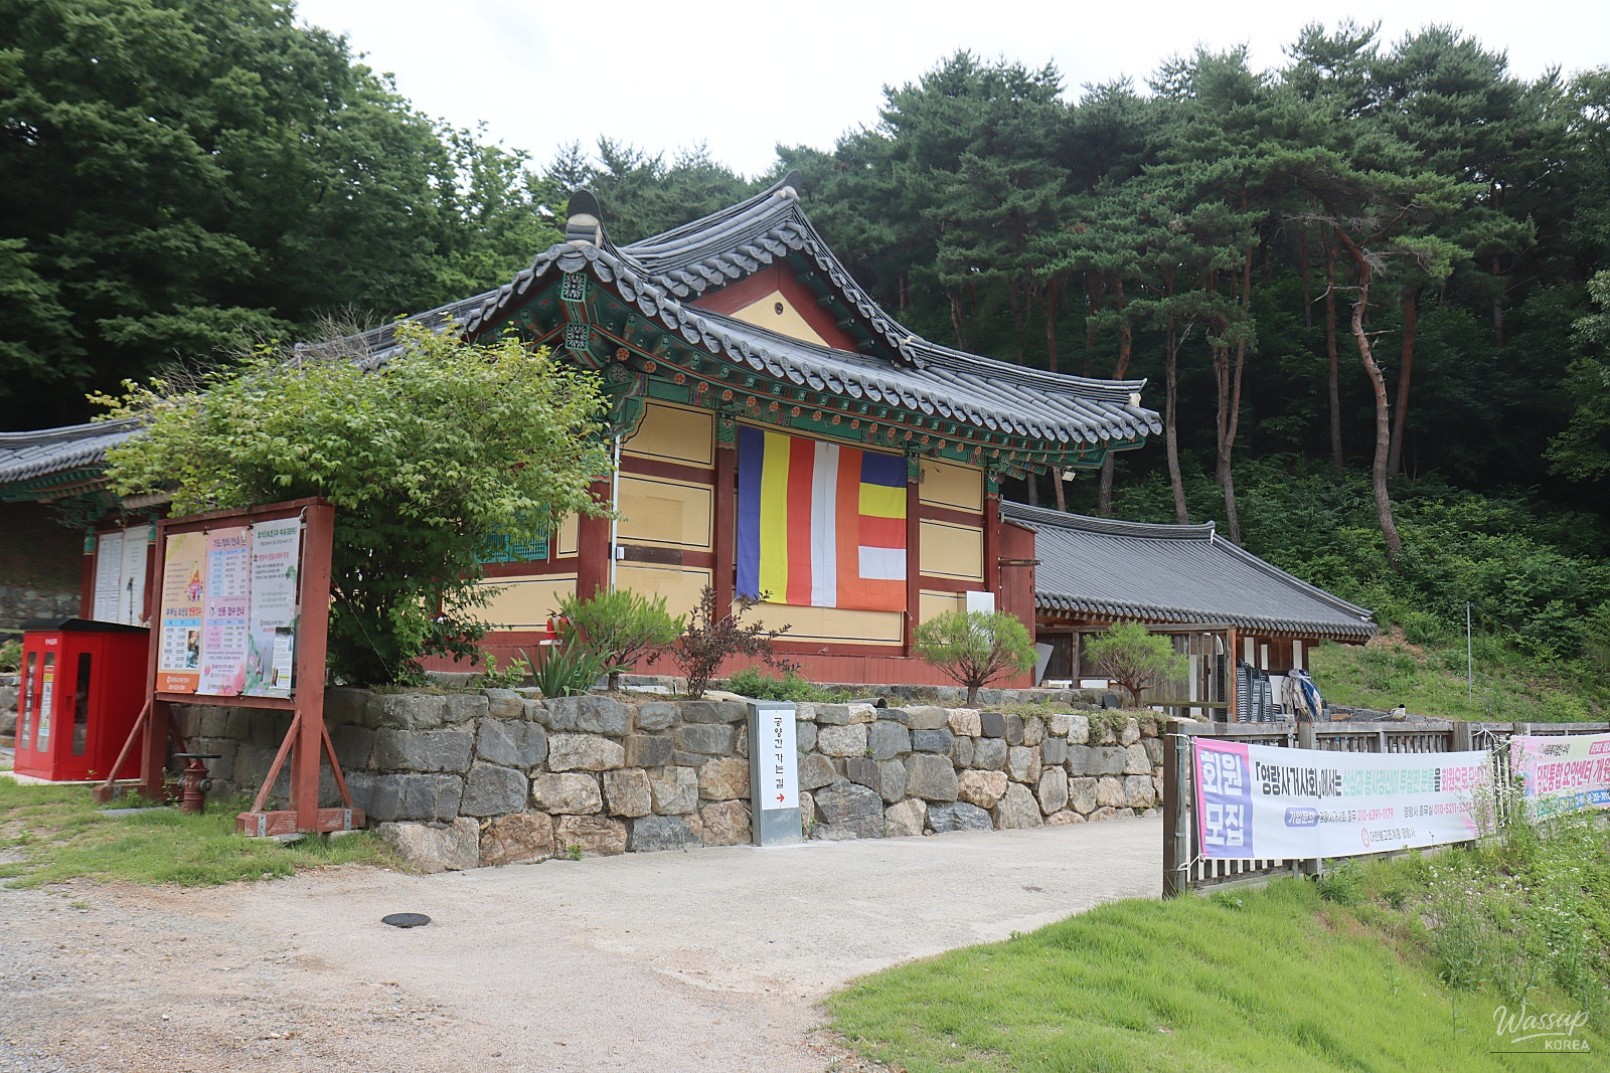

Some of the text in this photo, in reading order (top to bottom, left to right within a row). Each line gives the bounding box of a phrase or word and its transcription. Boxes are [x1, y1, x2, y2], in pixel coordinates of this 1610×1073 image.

[774, 717, 784, 789] 공양간 가는 길
[1200, 750, 1243, 796] 회원
[1205, 803, 1244, 846] 모집
[1289, 810, 1316, 824] 가입문의
[1404, 805, 1418, 818] 영랑사
